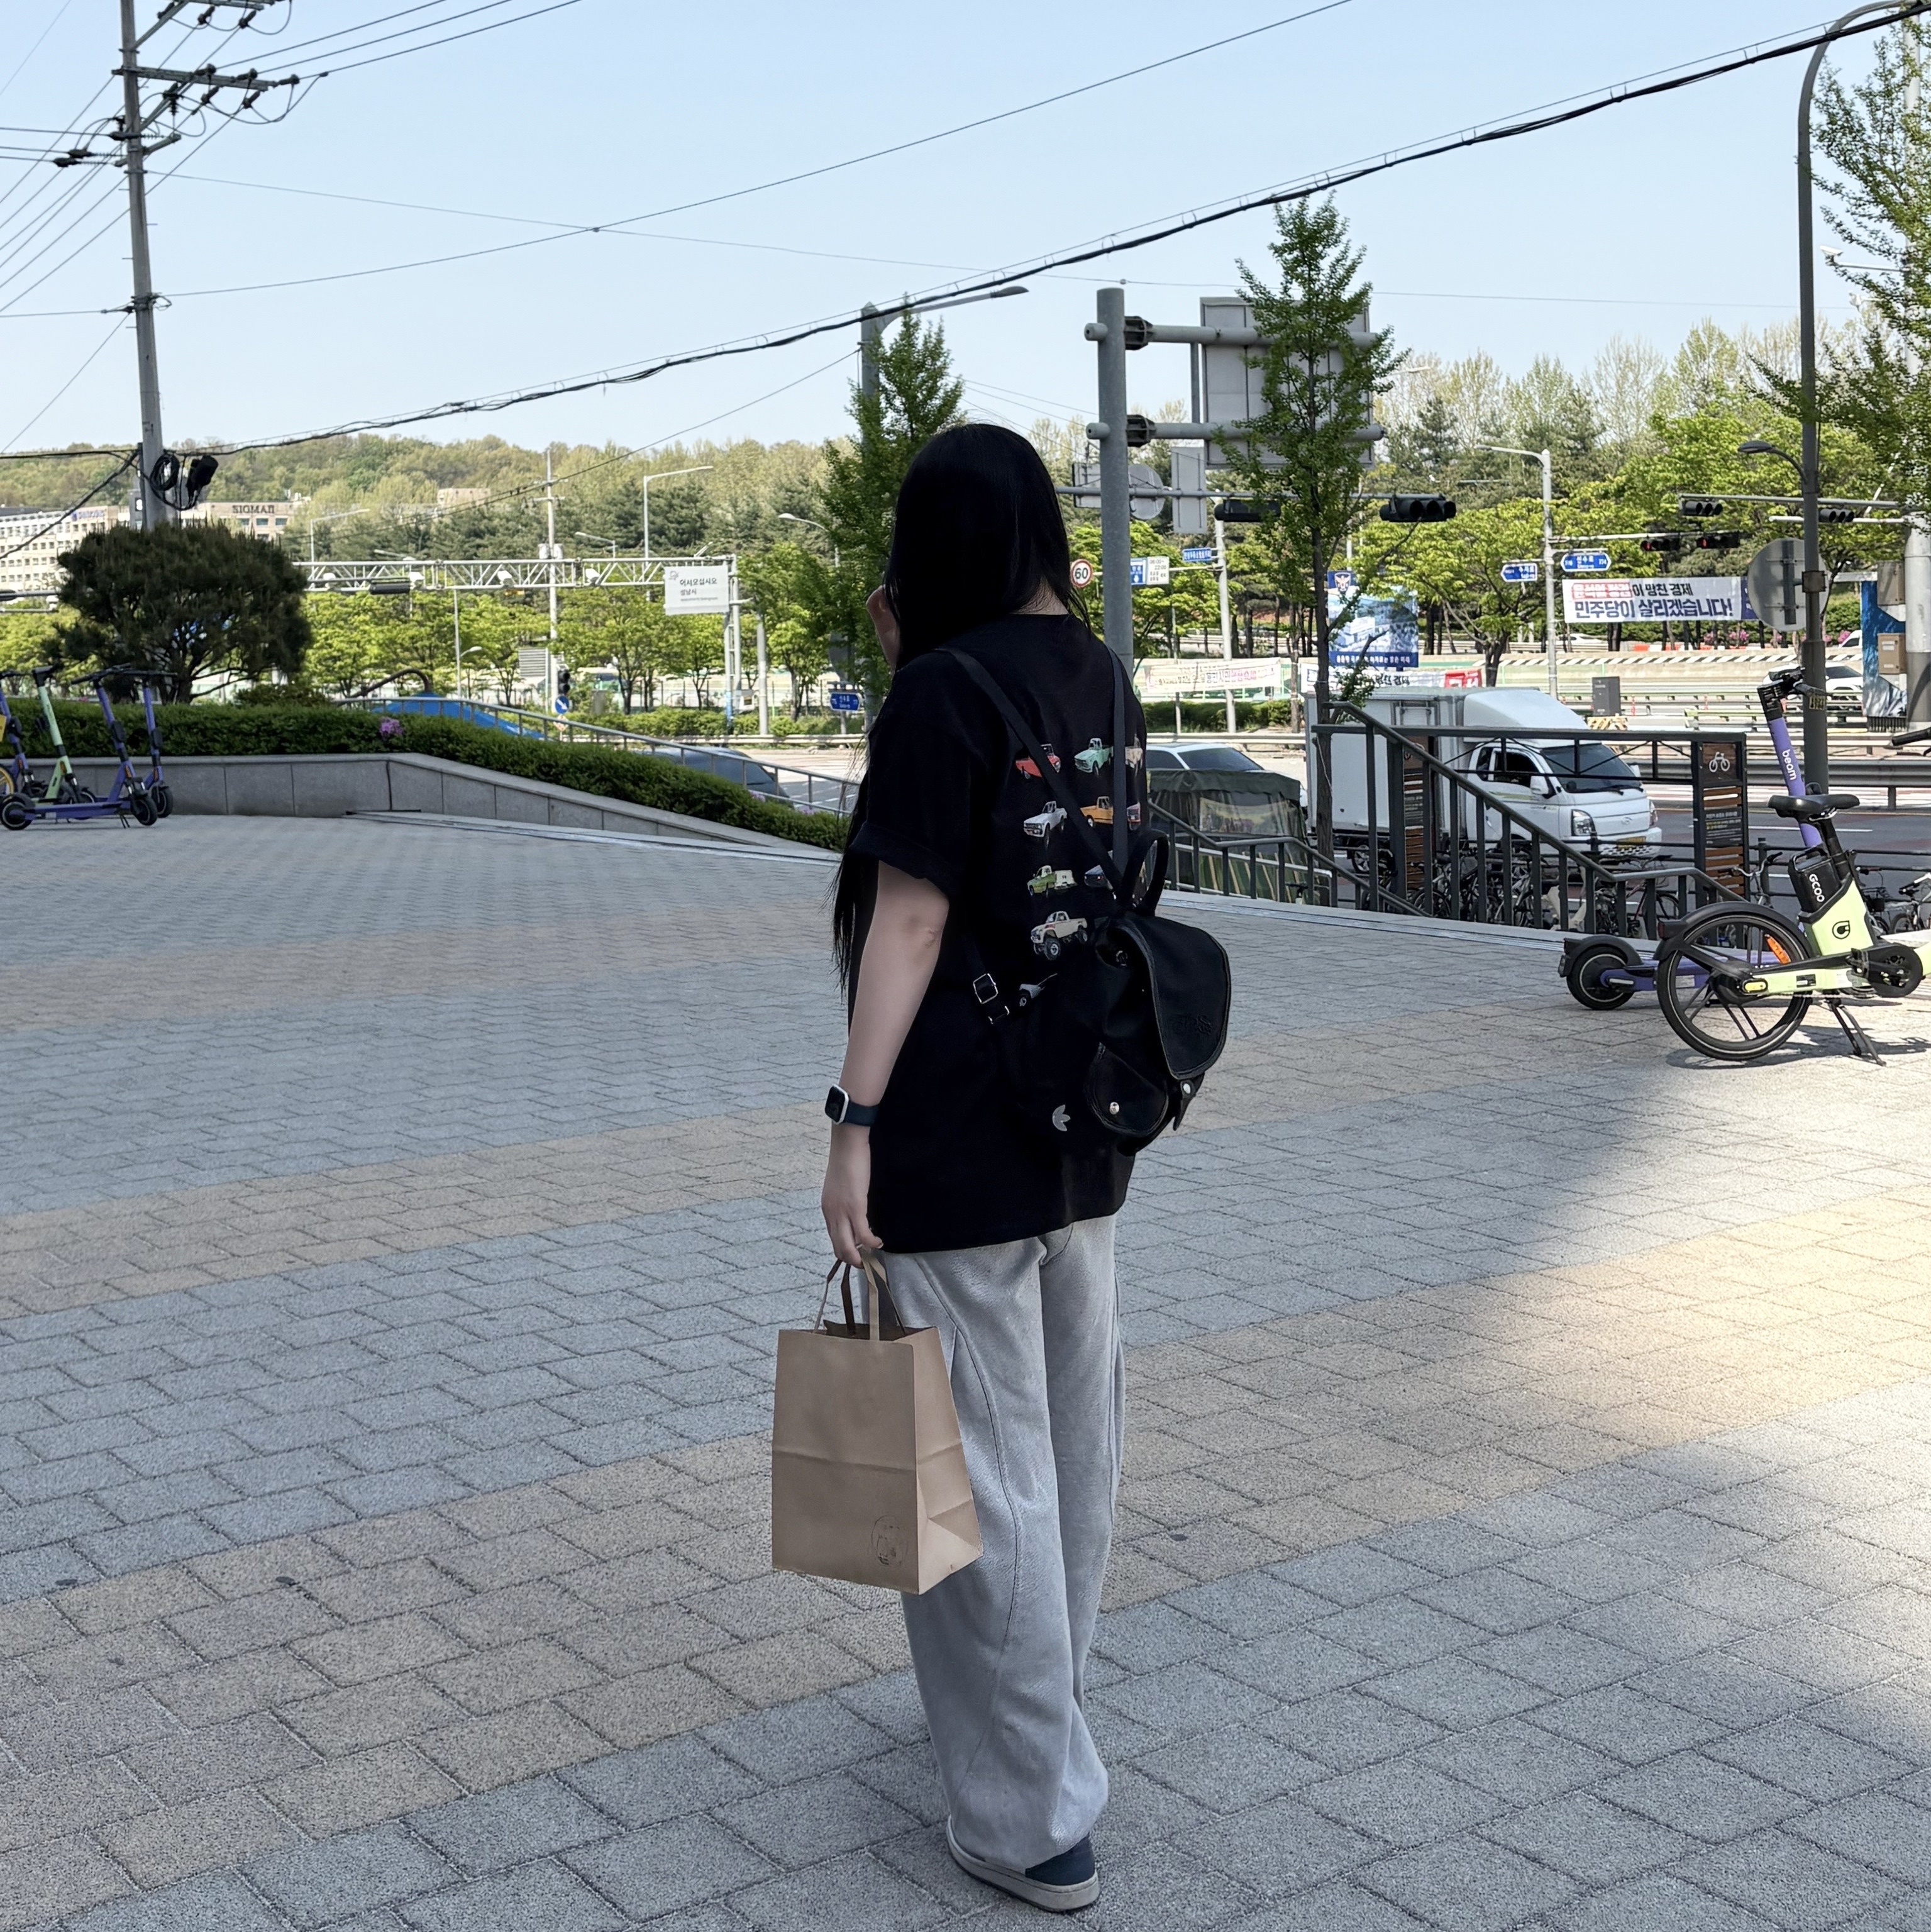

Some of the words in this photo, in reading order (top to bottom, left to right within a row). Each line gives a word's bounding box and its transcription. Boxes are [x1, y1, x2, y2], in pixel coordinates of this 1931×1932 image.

[1075, 568, 1088, 579] 60
[1645, 583, 1669, 596] 망친
[1669, 583, 1694, 596] 경제
[1574, 599, 1635, 618] 민주당이
[1638, 598, 1734, 617] 살리겠습니다!
[1782, 748, 1797, 780] beam
[1809, 874, 1825, 902] GCOO
